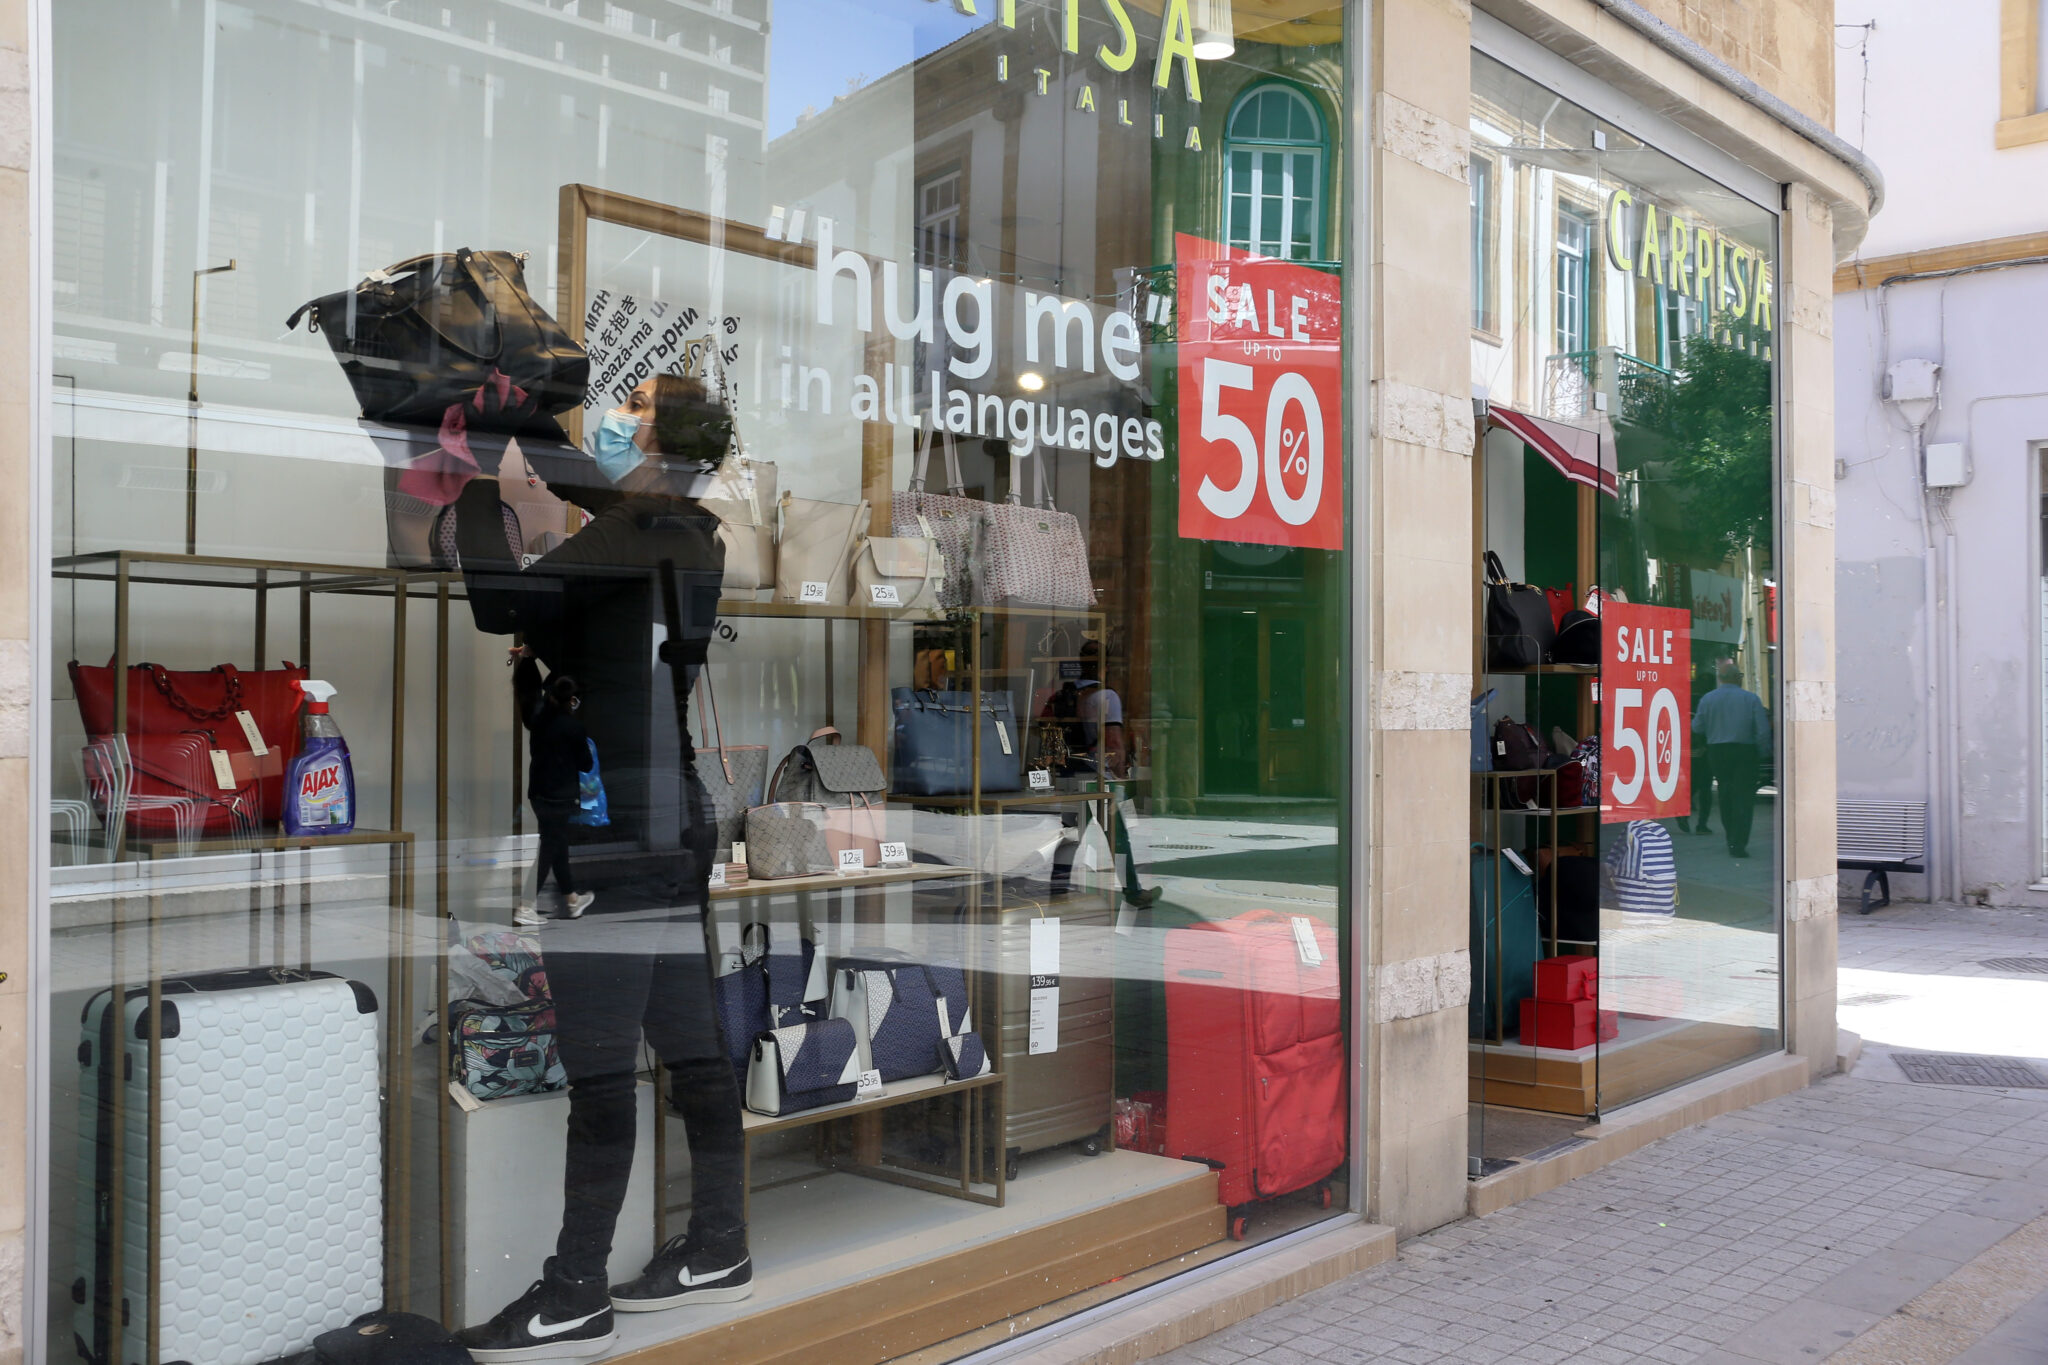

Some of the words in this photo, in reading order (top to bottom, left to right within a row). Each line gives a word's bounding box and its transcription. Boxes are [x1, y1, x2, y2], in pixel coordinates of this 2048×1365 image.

[997, 54, 1202, 151] ITALIA
[1606, 190, 1772, 331] CARPISA
[1206, 273, 1310, 344] SALE
[1243, 340, 1260, 357] UP
[1266, 344, 1282, 362] TO
[1695, 317, 1772, 362] ITALIA
[779, 344, 832, 416] in
[849, 362, 920, 428] all
[931, 369, 1164, 468] languages
[1617, 625, 1673, 665] SALE
[1636, 670, 1647, 682] UP
[1648, 671, 1658, 683] TO
[301, 765, 339, 798] AJAX
